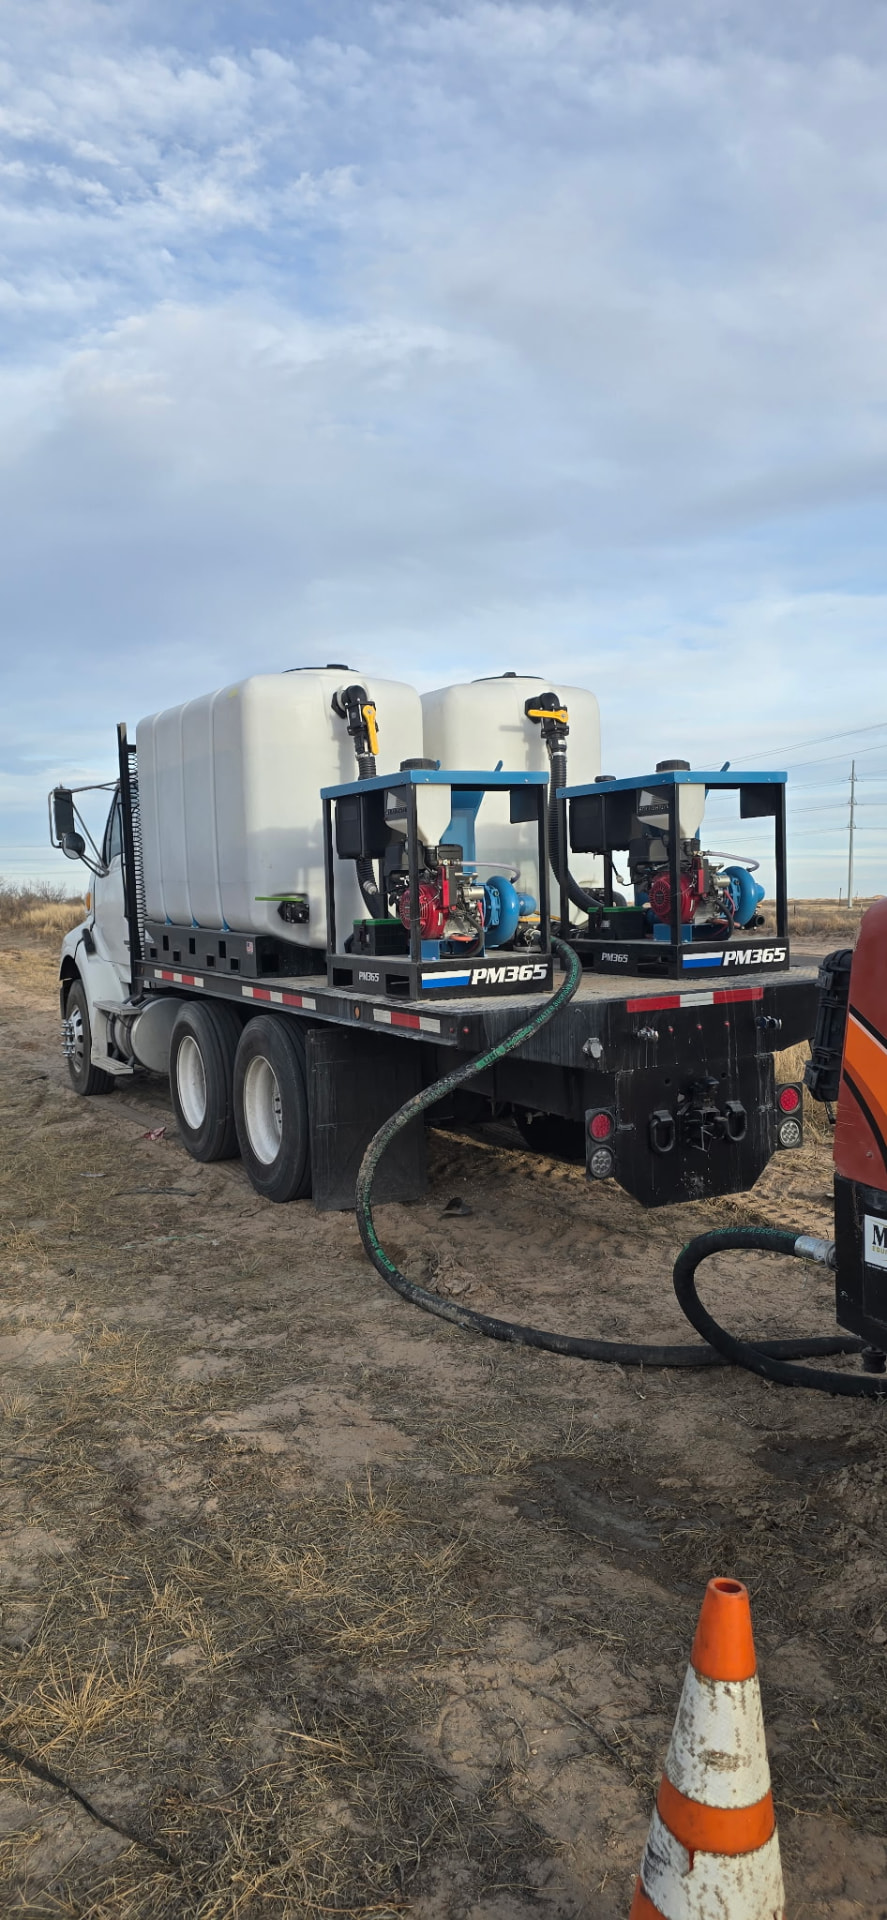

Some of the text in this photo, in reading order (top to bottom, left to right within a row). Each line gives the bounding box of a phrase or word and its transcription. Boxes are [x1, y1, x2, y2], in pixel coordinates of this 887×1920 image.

[601, 952, 629, 963] PM365
[722, 947, 787, 967] PM365
[358, 971, 380, 983] PM365
[471, 963, 549, 985] PM365
[535, 1005, 555, 1024] WATER
